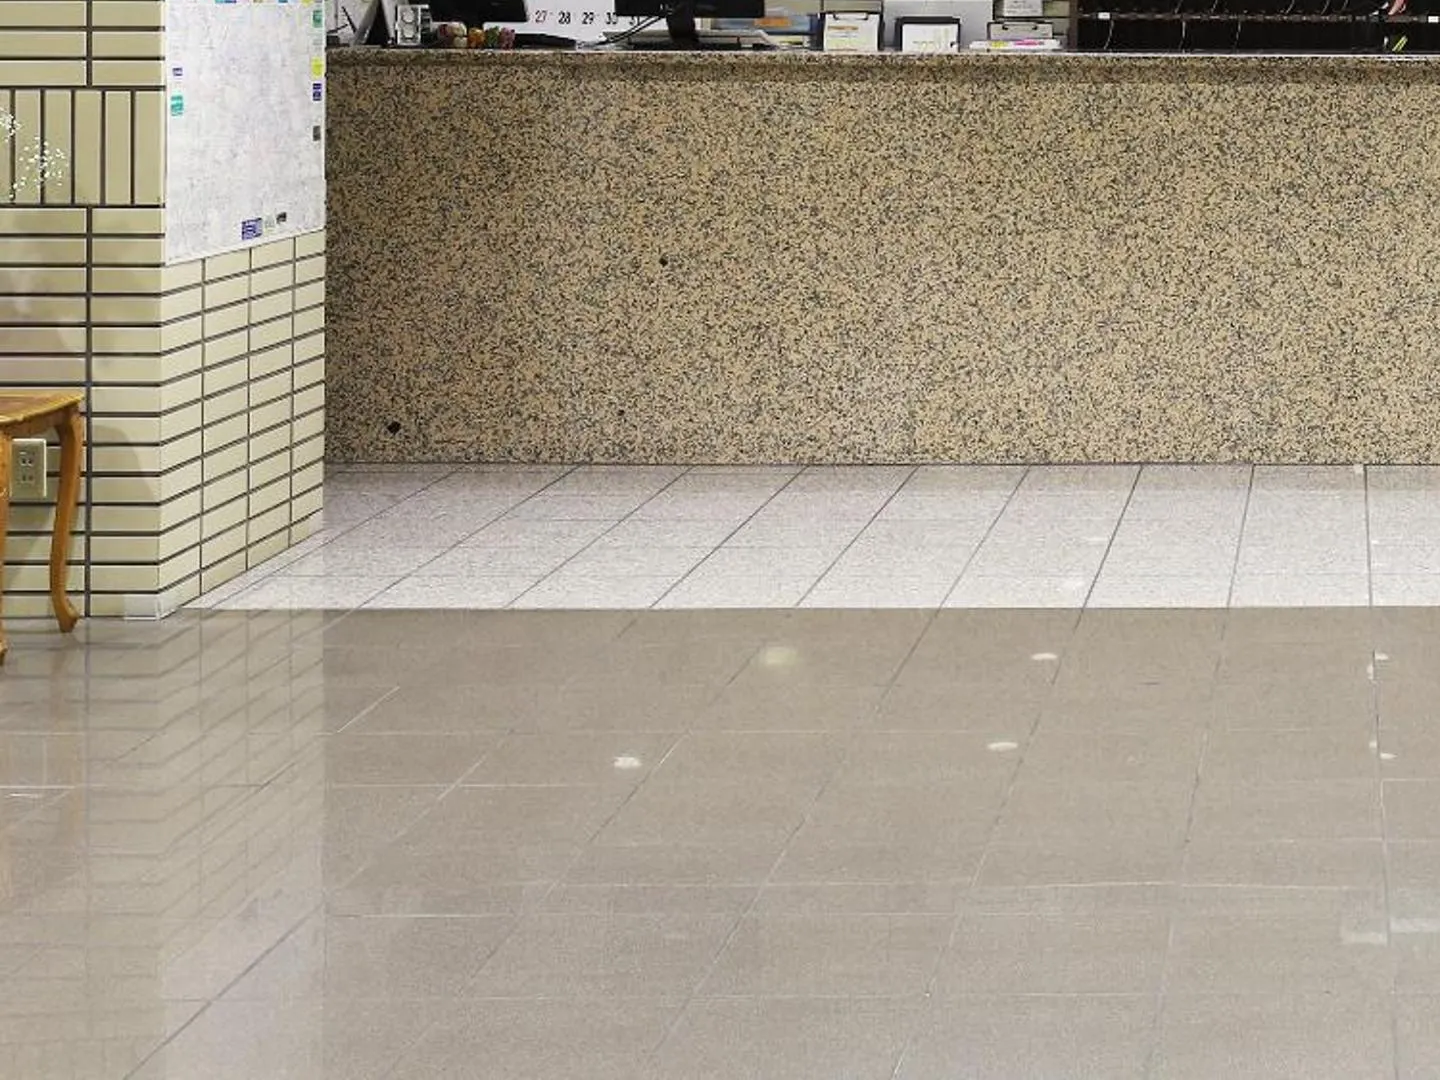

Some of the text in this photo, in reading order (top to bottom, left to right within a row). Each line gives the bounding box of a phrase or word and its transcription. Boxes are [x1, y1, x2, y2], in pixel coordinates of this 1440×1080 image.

[535, 10, 548, 24] 27
[558, 11, 571, 24] 28
[582, 11, 595, 25] 29
[606, 12, 618, 25] 30
